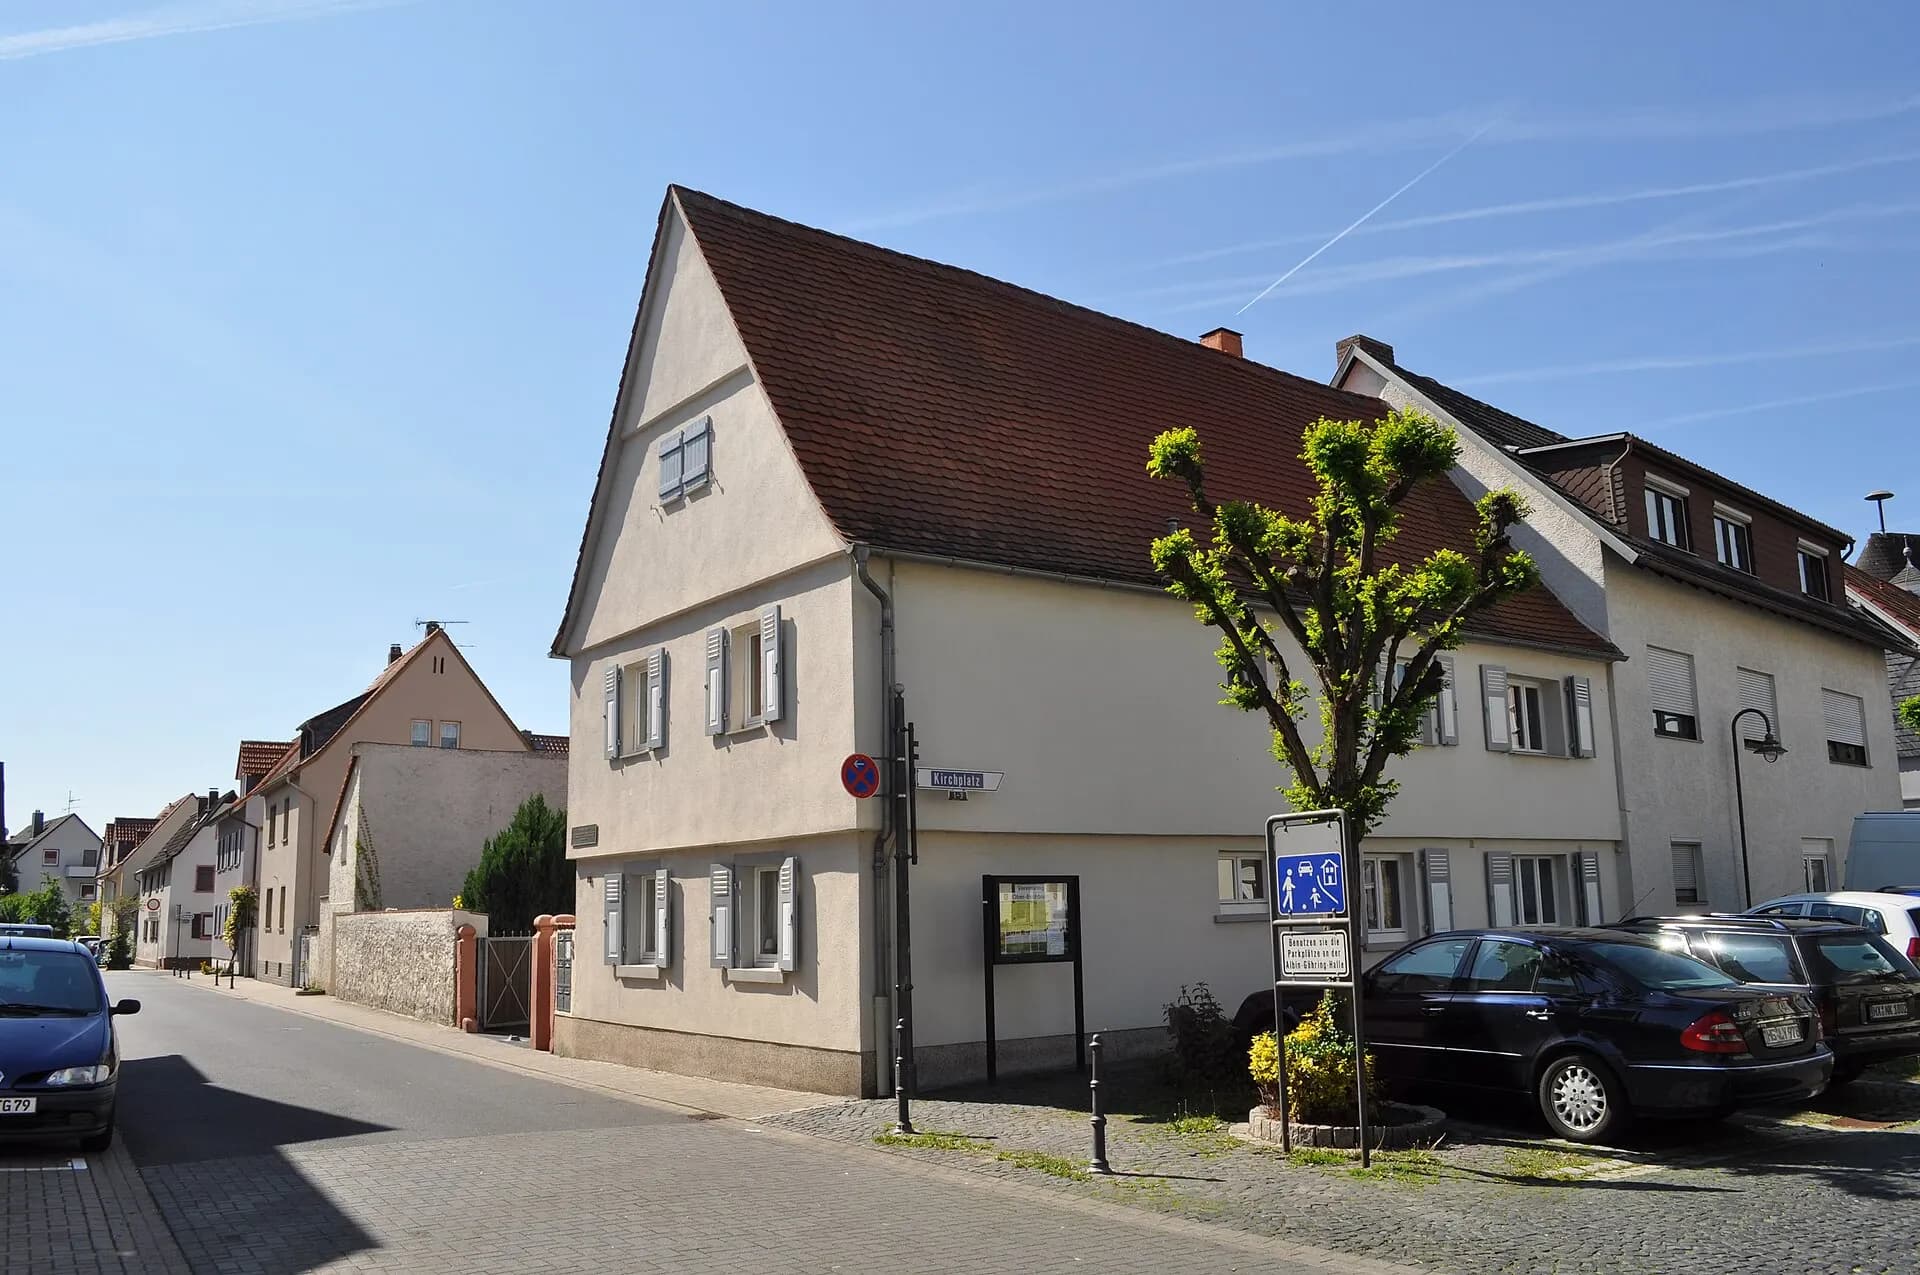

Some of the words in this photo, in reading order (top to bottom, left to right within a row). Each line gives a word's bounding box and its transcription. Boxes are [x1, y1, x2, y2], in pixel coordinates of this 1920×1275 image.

[934, 772, 980, 787] Kirchplatz
[1288, 938, 1316, 947] Benutzen
[1331, 937, 1340, 946] die
[1287, 950, 1320, 958] Parkplätze
[1332, 949, 1341, 957] der
[1286, 960, 1344, 970] Albin-Göhring-Halle
[0, 1100, 11, 1111] G
[14, 1100, 30, 1111] 79
